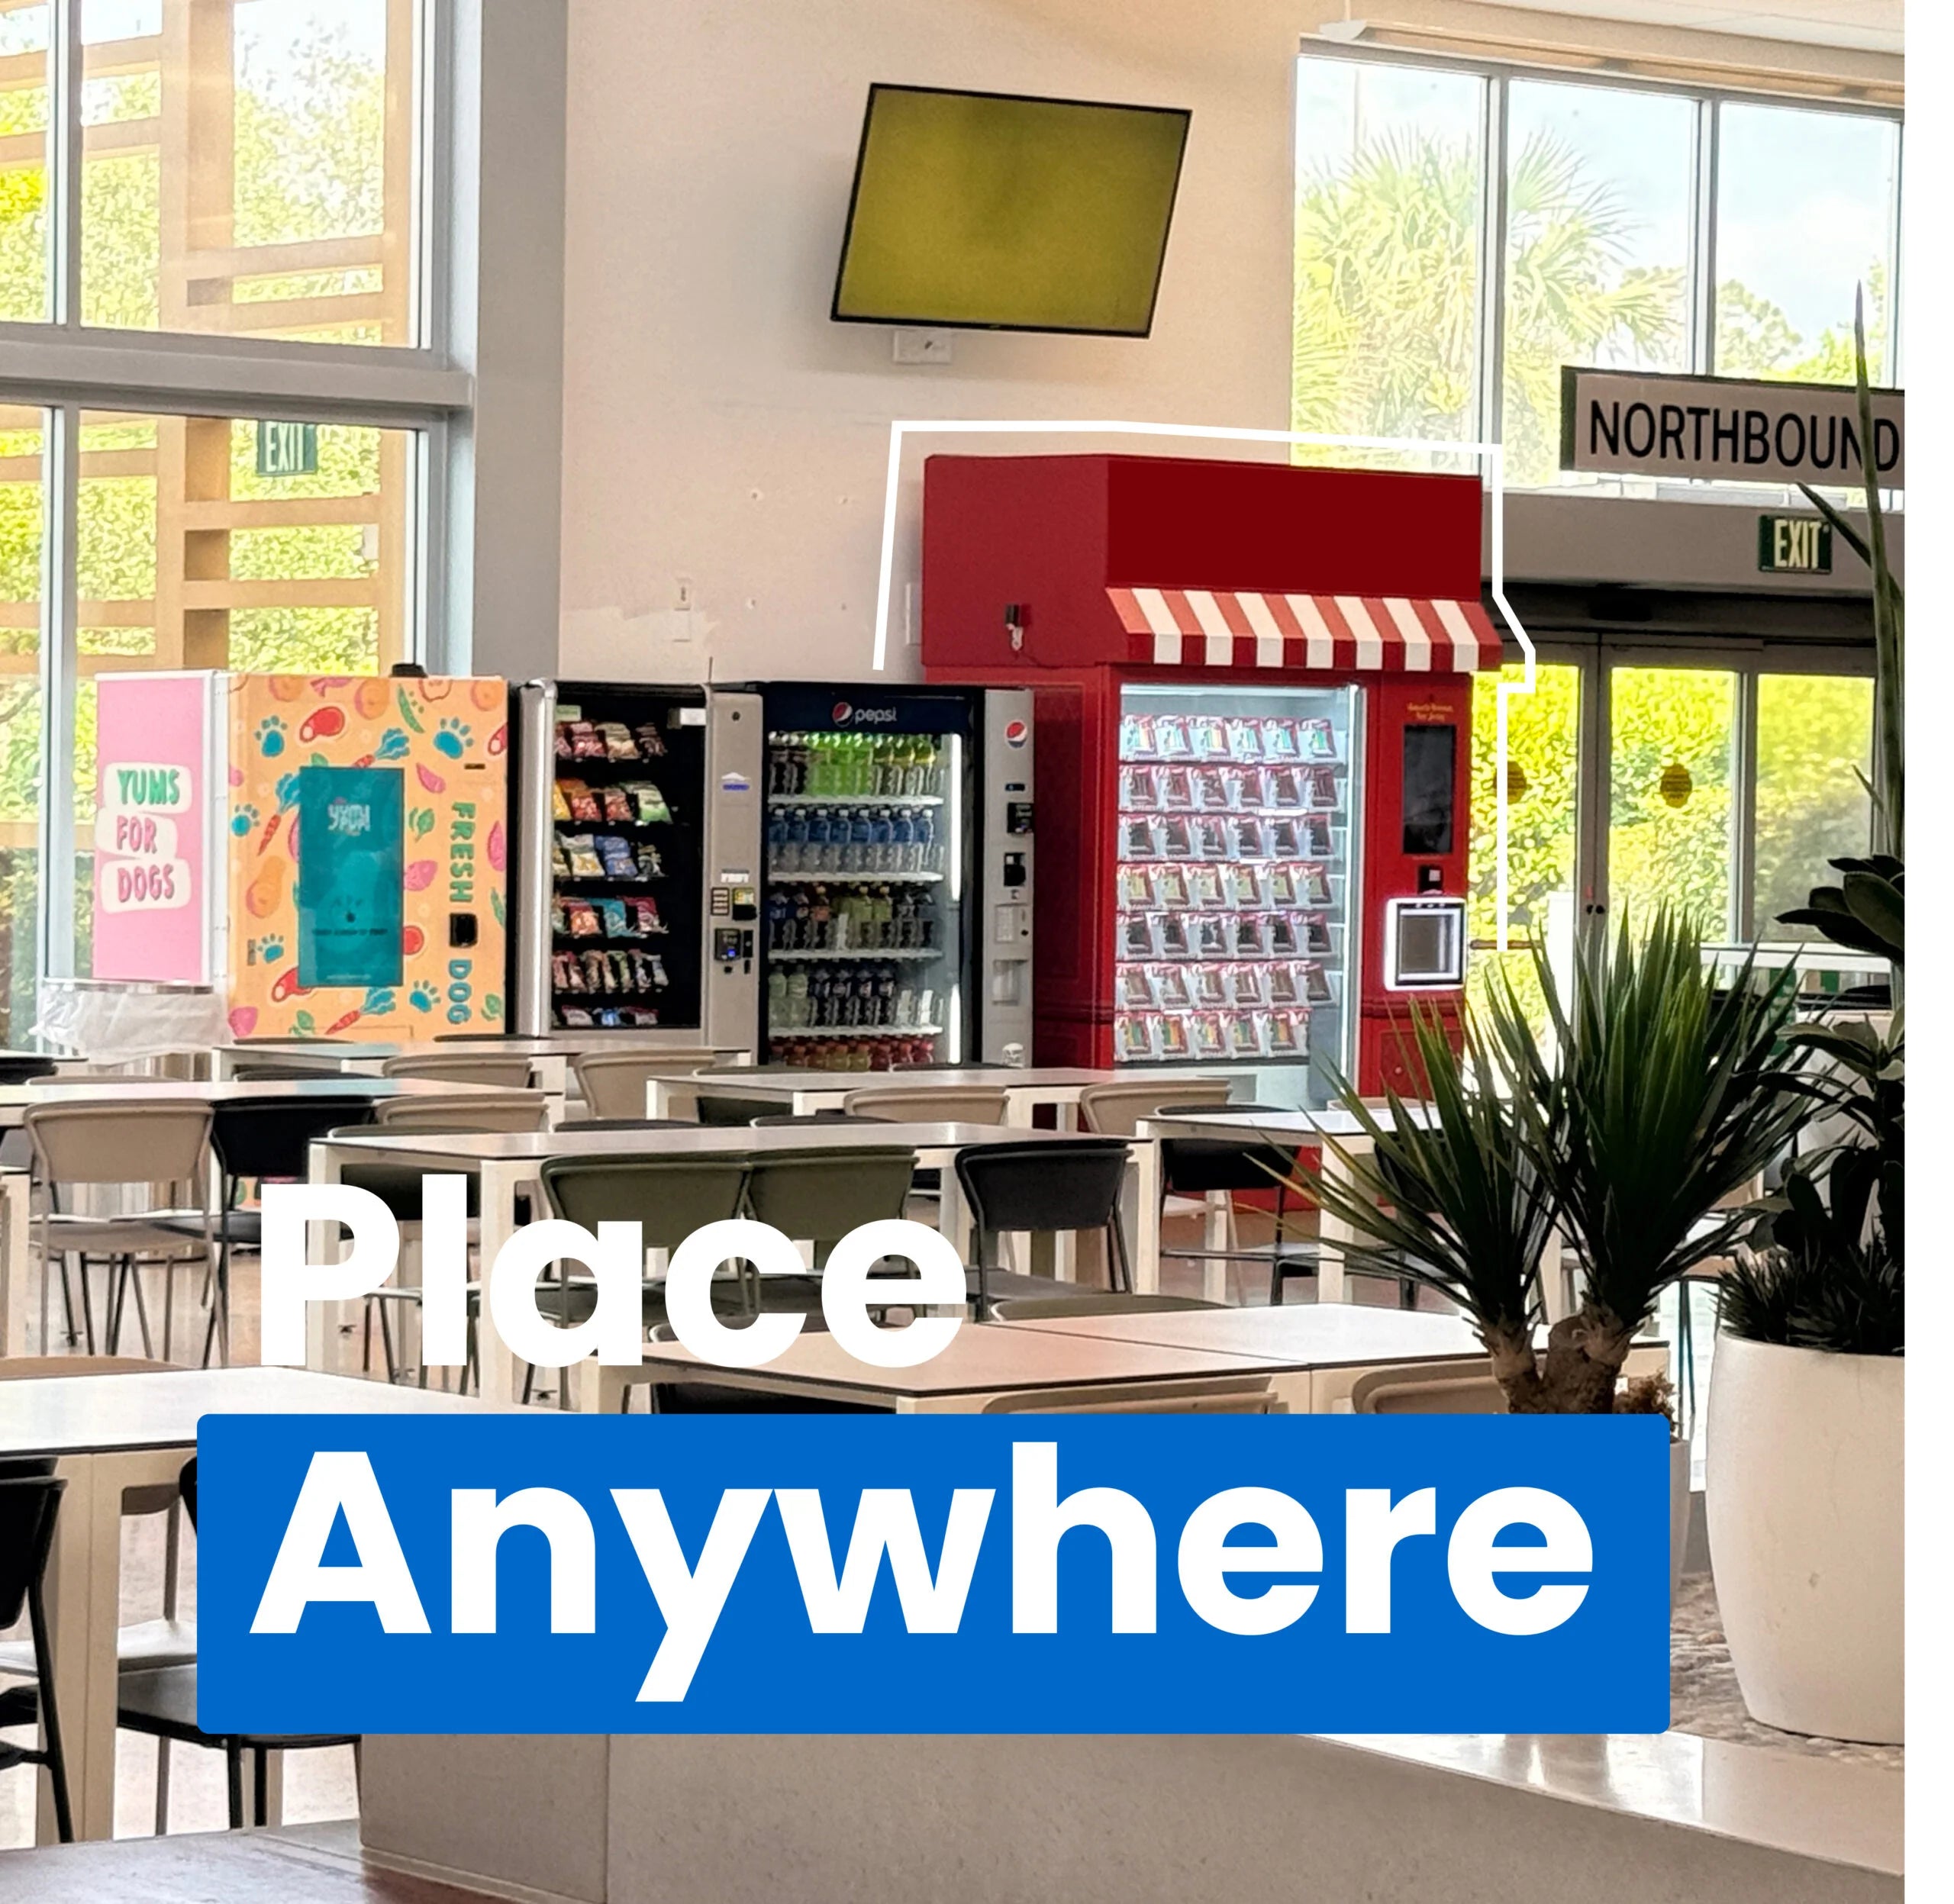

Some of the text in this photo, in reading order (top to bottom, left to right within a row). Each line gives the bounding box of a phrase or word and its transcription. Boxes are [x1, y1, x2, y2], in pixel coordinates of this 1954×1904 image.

[265, 420, 305, 472] EXIT
[1590, 400, 1900, 472] NORTHBOUND
[1775, 519, 1822, 569] EXIT
[855, 707, 897, 724] pepsi
[117, 768, 179, 805] YUMS
[116, 814, 157, 854] FOR
[117, 863, 175, 903] DOGS
[447, 801, 476, 1024] FRESH DOG
